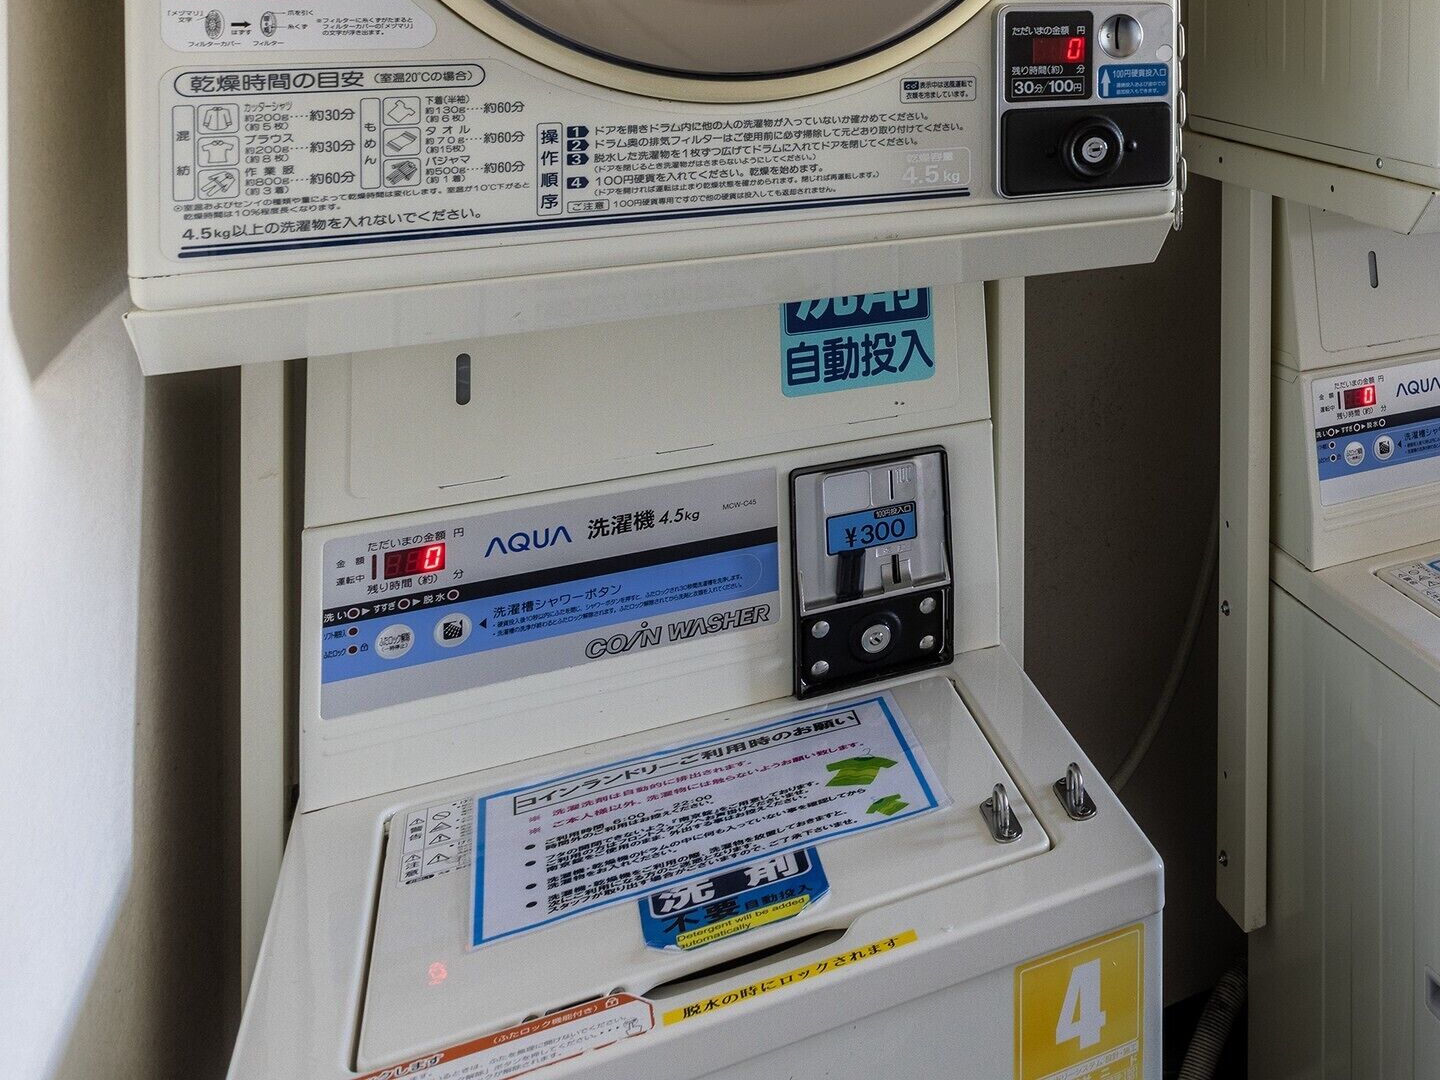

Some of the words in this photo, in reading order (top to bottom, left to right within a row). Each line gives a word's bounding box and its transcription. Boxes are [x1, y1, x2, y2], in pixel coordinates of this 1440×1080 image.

[1012, 25, 1069, 36] ただいまの金額
[1076, 25, 1086, 35] 円
[1067, 38, 1081, 60] 0
[1076, 64, 1085, 74] 分
[190, 71, 364, 93] 乾燥時間の目安
[309, 108, 355, 121] 約30分
[483, 101, 525, 114] 約60分
[309, 139, 355, 153] 約30分
[364, 123, 377, 165] もめん
[483, 131, 525, 144] 約60分
[571, 140, 582, 151] 2
[483, 161, 525, 174] 約60分
[540, 129, 559, 210] 操作順序
[571, 154, 582, 165] 3
[309, 171, 355, 185] 約60分
[570, 178, 582, 188] 4
[572, 202, 604, 212] ご注意
[787, 329, 933, 386] 自動投入
[1363, 389, 1373, 404] 0
[1396, 377, 1440, 397] AQUA
[722, 499, 757, 510] MCW-C45
[587, 509, 655, 540] 洗濯機
[658, 508, 701, 526] 4.5kg
[844, 518, 906, 547] ¥300
[368, 530, 446, 552] ただいまの金額
[453, 527, 465, 538] 円
[484, 524, 573, 559] AQUA
[424, 546, 441, 569] 0
[453, 569, 464, 579] 分
[423, 592, 446, 605] 脱水
[493, 584, 622, 619] 洗濯槽シャワーボタン
[585, 622, 662, 659] COIN
[668, 603, 771, 642] WASHER
[516, 716, 855, 810] コインランドリーご利用時のお願い
[677, 918, 733, 942] Detergent
[733, 913, 753, 926] will
[755, 907, 769, 918] be
[772, 897, 805, 913] added
[683, 937, 899, 1019] 脱水の時にロックされます
[1056, 958, 1106, 1050] 4
